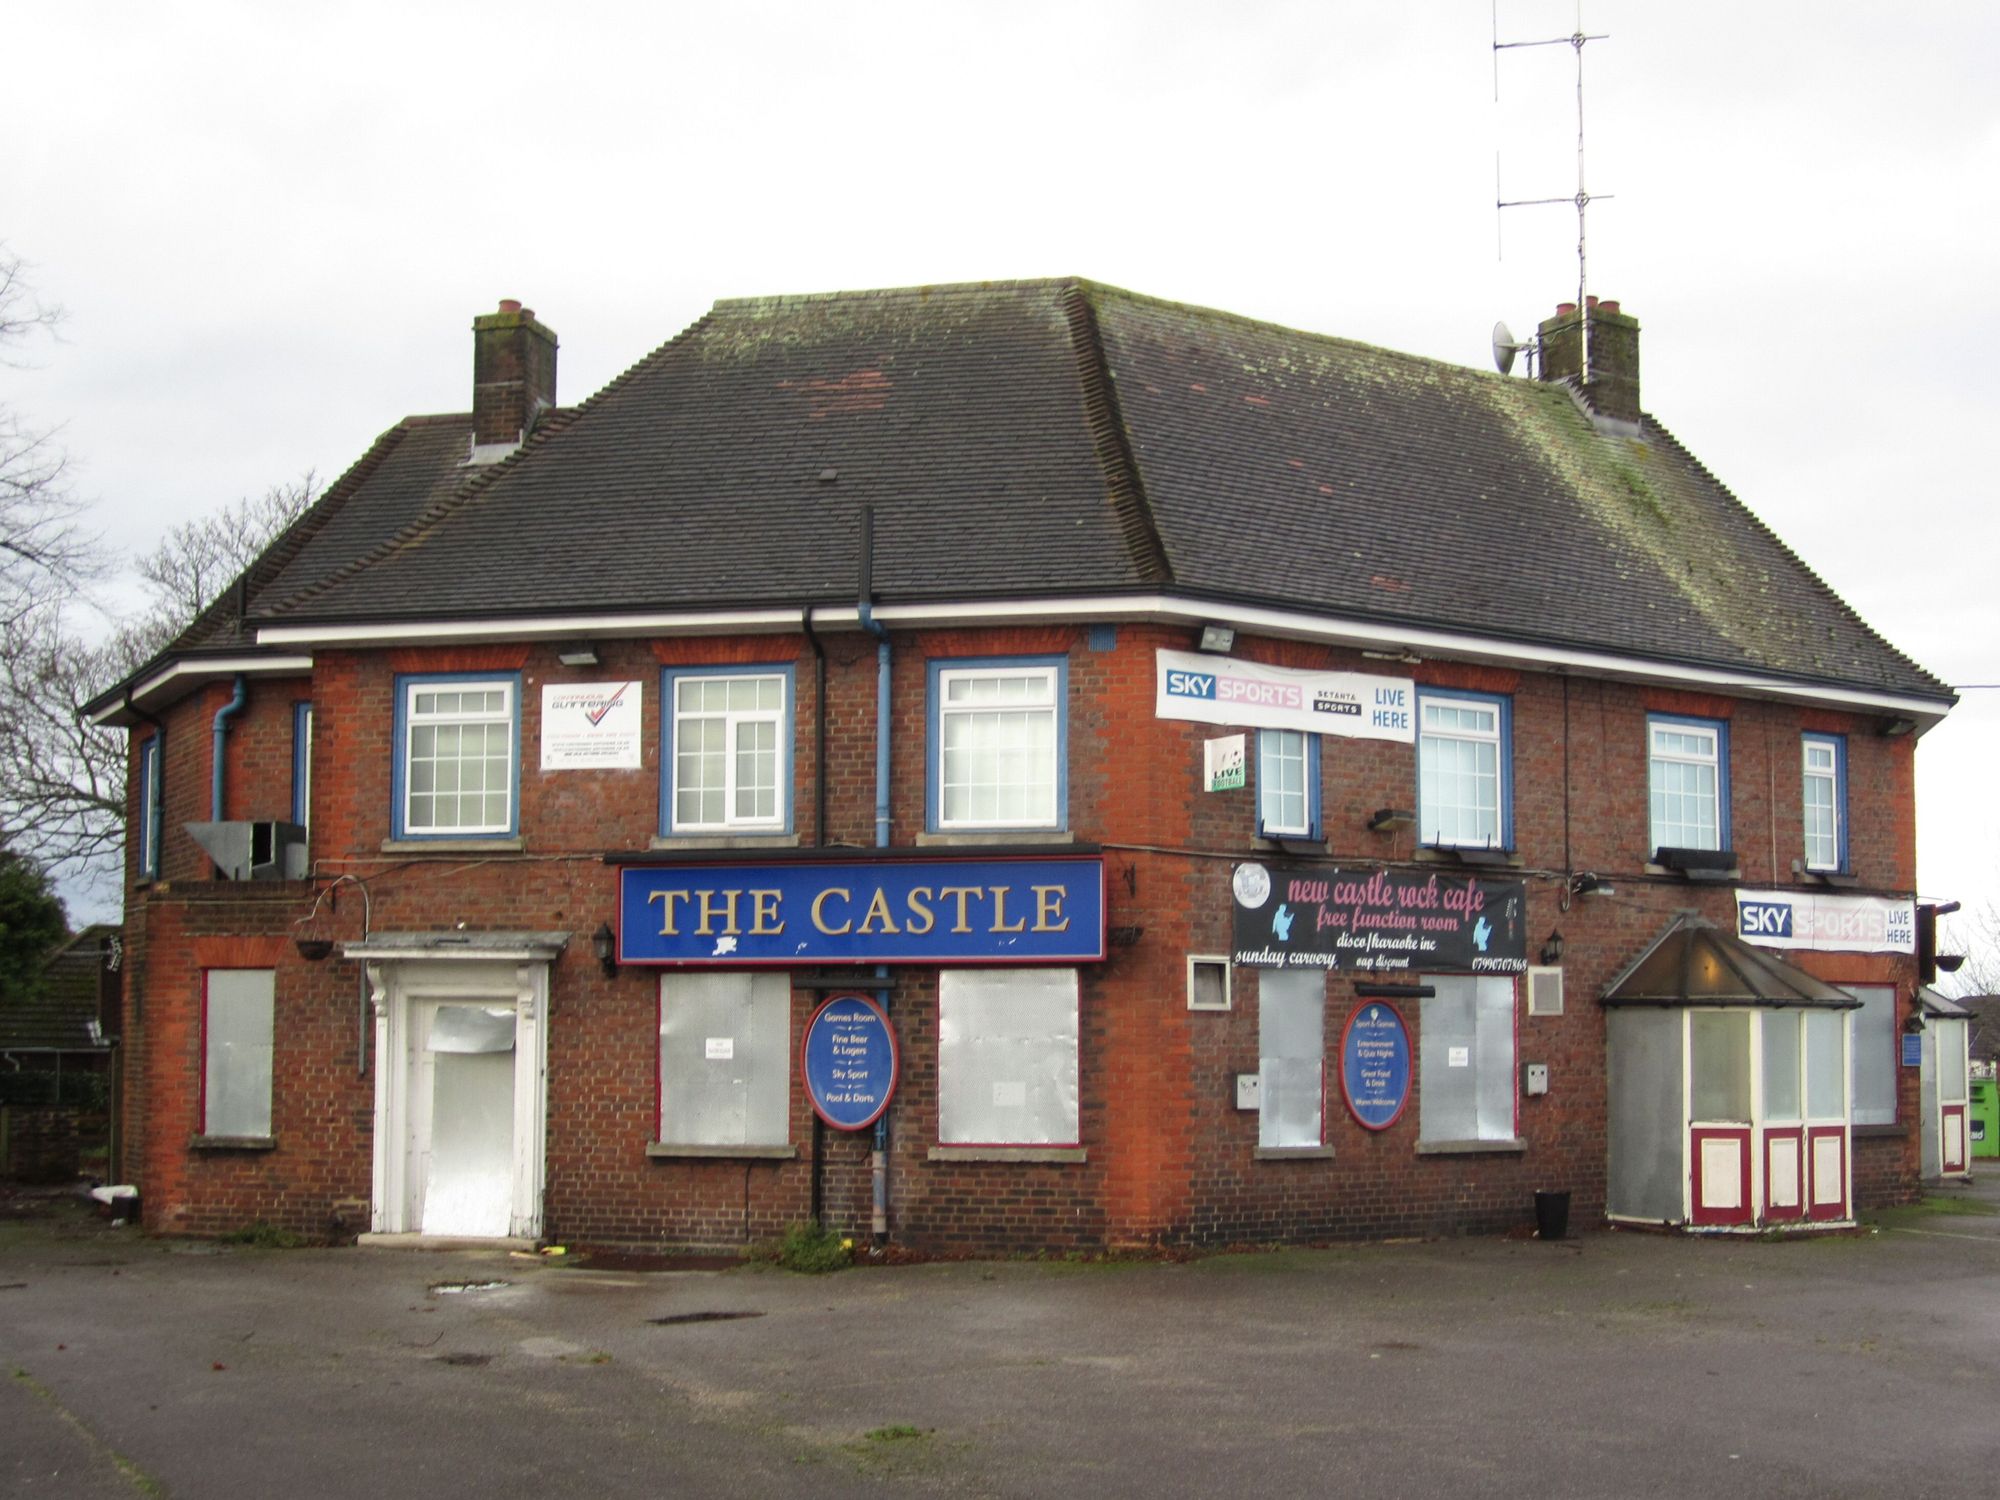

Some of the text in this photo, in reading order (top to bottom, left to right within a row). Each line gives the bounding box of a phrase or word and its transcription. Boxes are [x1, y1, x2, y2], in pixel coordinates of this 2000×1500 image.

[1170, 673, 1300, 707] SKY SPORTS
[1317, 690, 1356, 701] SETANTA
[1375, 688, 1405, 707] LIVE
[1317, 702, 1357, 714] SPORTS
[1372, 709, 1408, 729] HERE
[1214, 767, 1242, 779] LIVE
[1288, 871, 1484, 922] new castle rock cafe
[647, 884, 1071, 936] THE CASTLE
[1888, 909, 1909, 925] LIVE
[1317, 904, 1460, 933] free function room
[1742, 905, 1882, 938] SKY SPORTS
[1336, 931, 1437, 952] disco/karaoke inc
[1887, 929, 1912, 944] HERE
[1235, 944, 1287, 968] sunday
[1356, 953, 1410, 971] oap discount
[824, 1012, 876, 1022] Games Room
[1356, 1020, 1371, 1029] Sport
[1376, 1020, 1396, 1029] Games
[832, 1034, 868, 1043] Fine Beer
[832, 1046, 867, 1056] & Lagers
[832, 1069, 869, 1079] Sky Sport
[1377, 1069, 1391, 1078] Food
[1371, 1079, 1385, 1087] Drink
[826, 1093, 874, 1103] Pool & Darts
